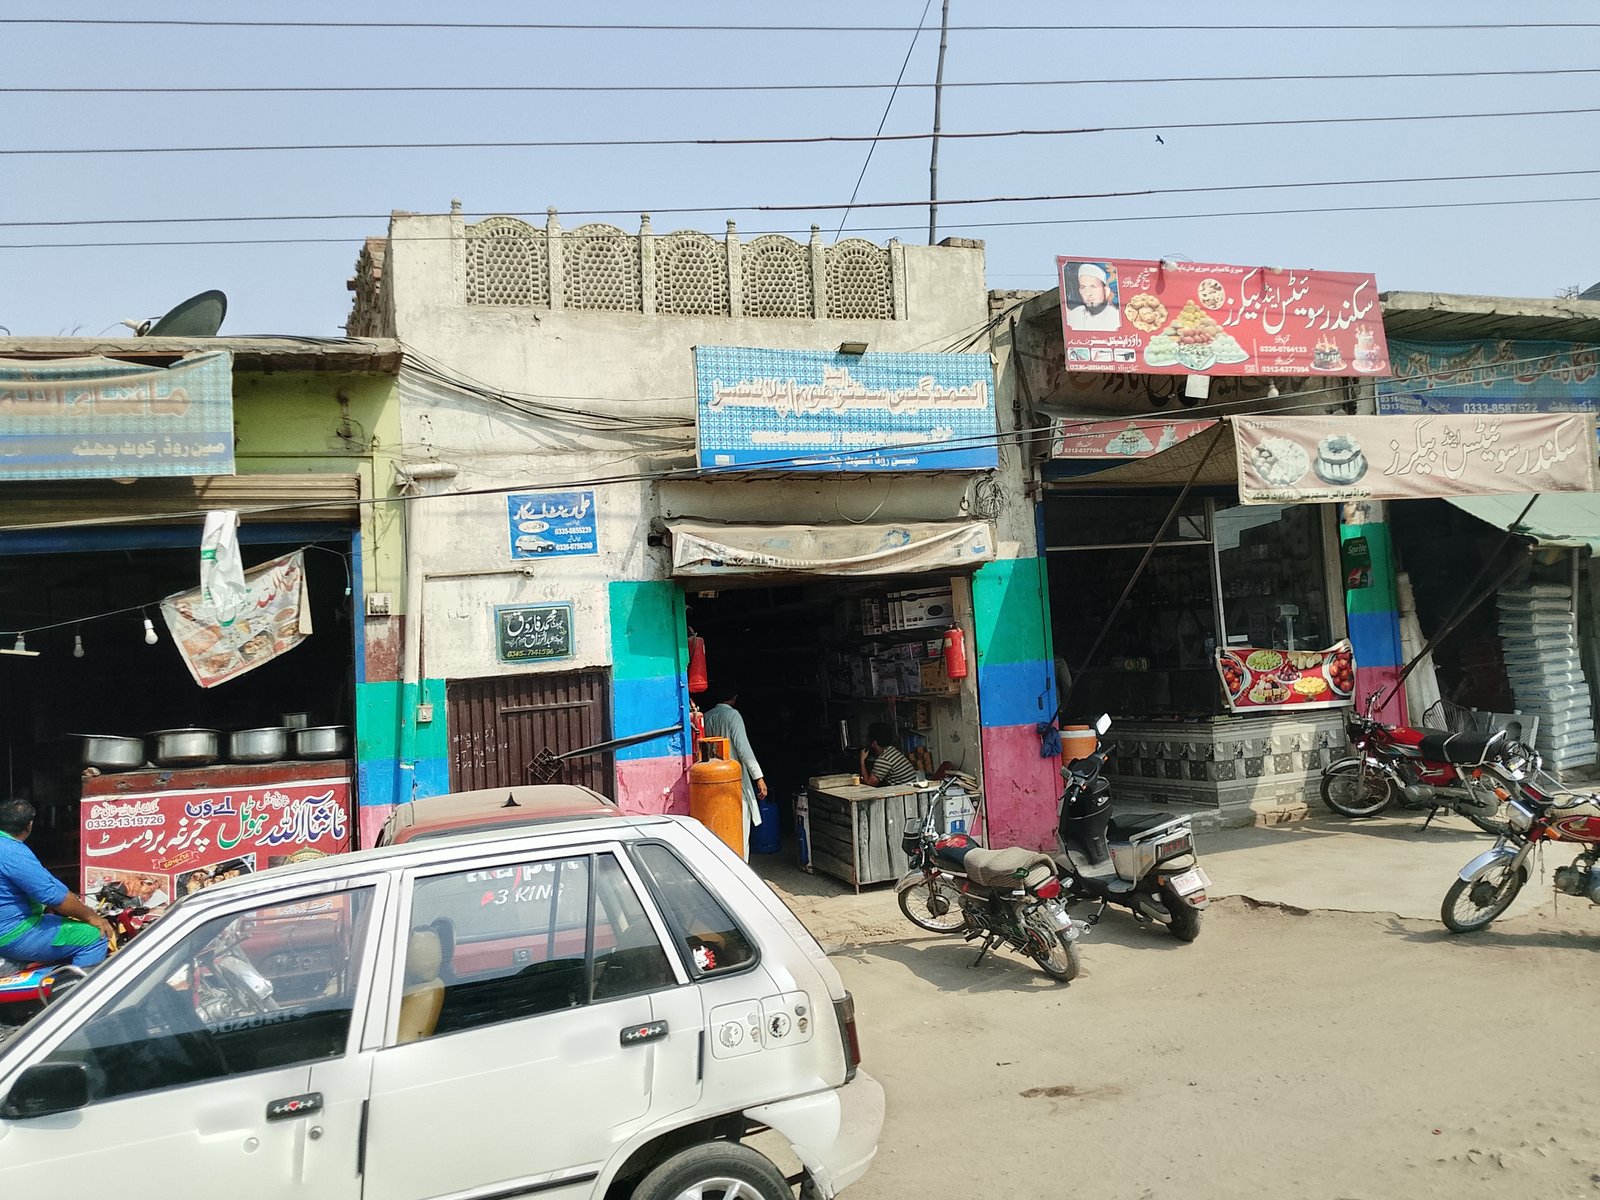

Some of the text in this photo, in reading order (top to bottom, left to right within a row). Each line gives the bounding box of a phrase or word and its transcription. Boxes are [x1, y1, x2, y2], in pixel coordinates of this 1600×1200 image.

[1319, 279, 1374, 330] سکندر
[888, 376, 931, 413] گیس
[931, 380, 985, 408] الحمد
[190, 441, 226, 457] مین
[1515, 416, 1577, 475] سکندر
[86, 815, 165, 829] 0332-1319726
[217, 795, 269, 850] ہوٹل
